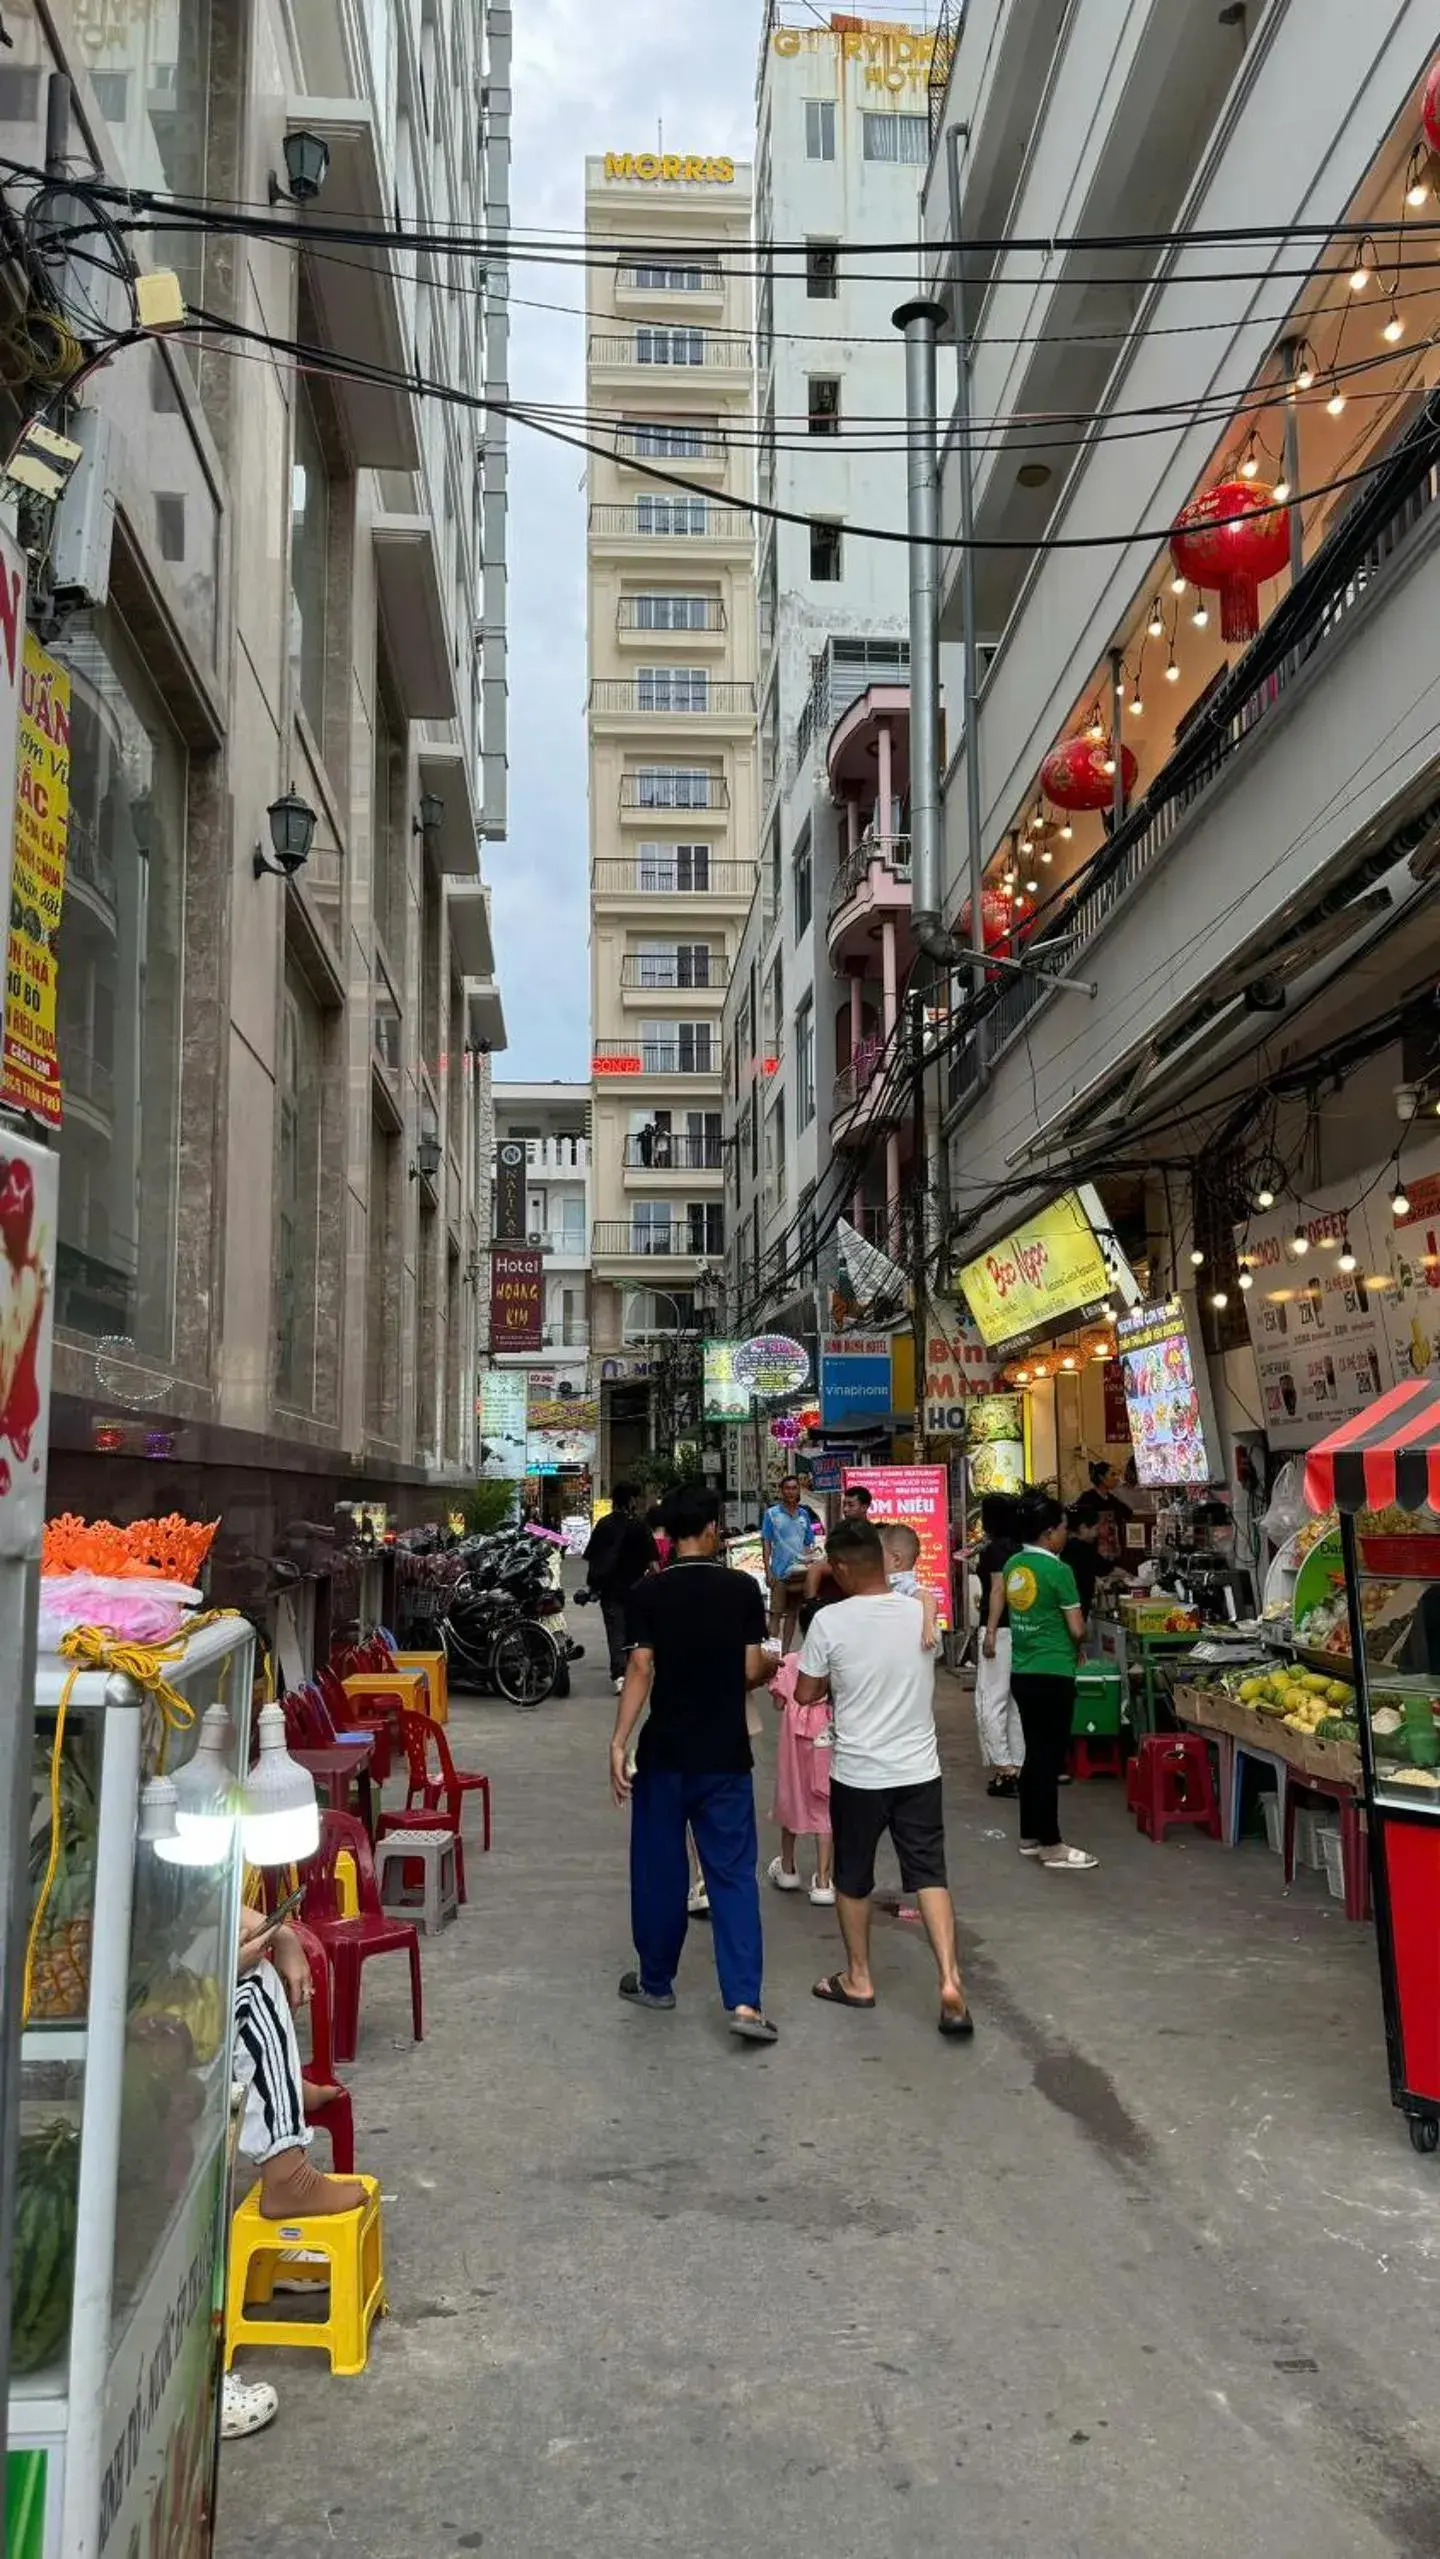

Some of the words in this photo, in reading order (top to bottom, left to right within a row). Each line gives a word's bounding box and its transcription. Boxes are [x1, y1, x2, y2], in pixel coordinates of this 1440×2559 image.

[604, 152, 735, 183] MORRIS
[496, 1258, 539, 1273] Hotel
[729, 1431, 738, 1488] HOTEL
